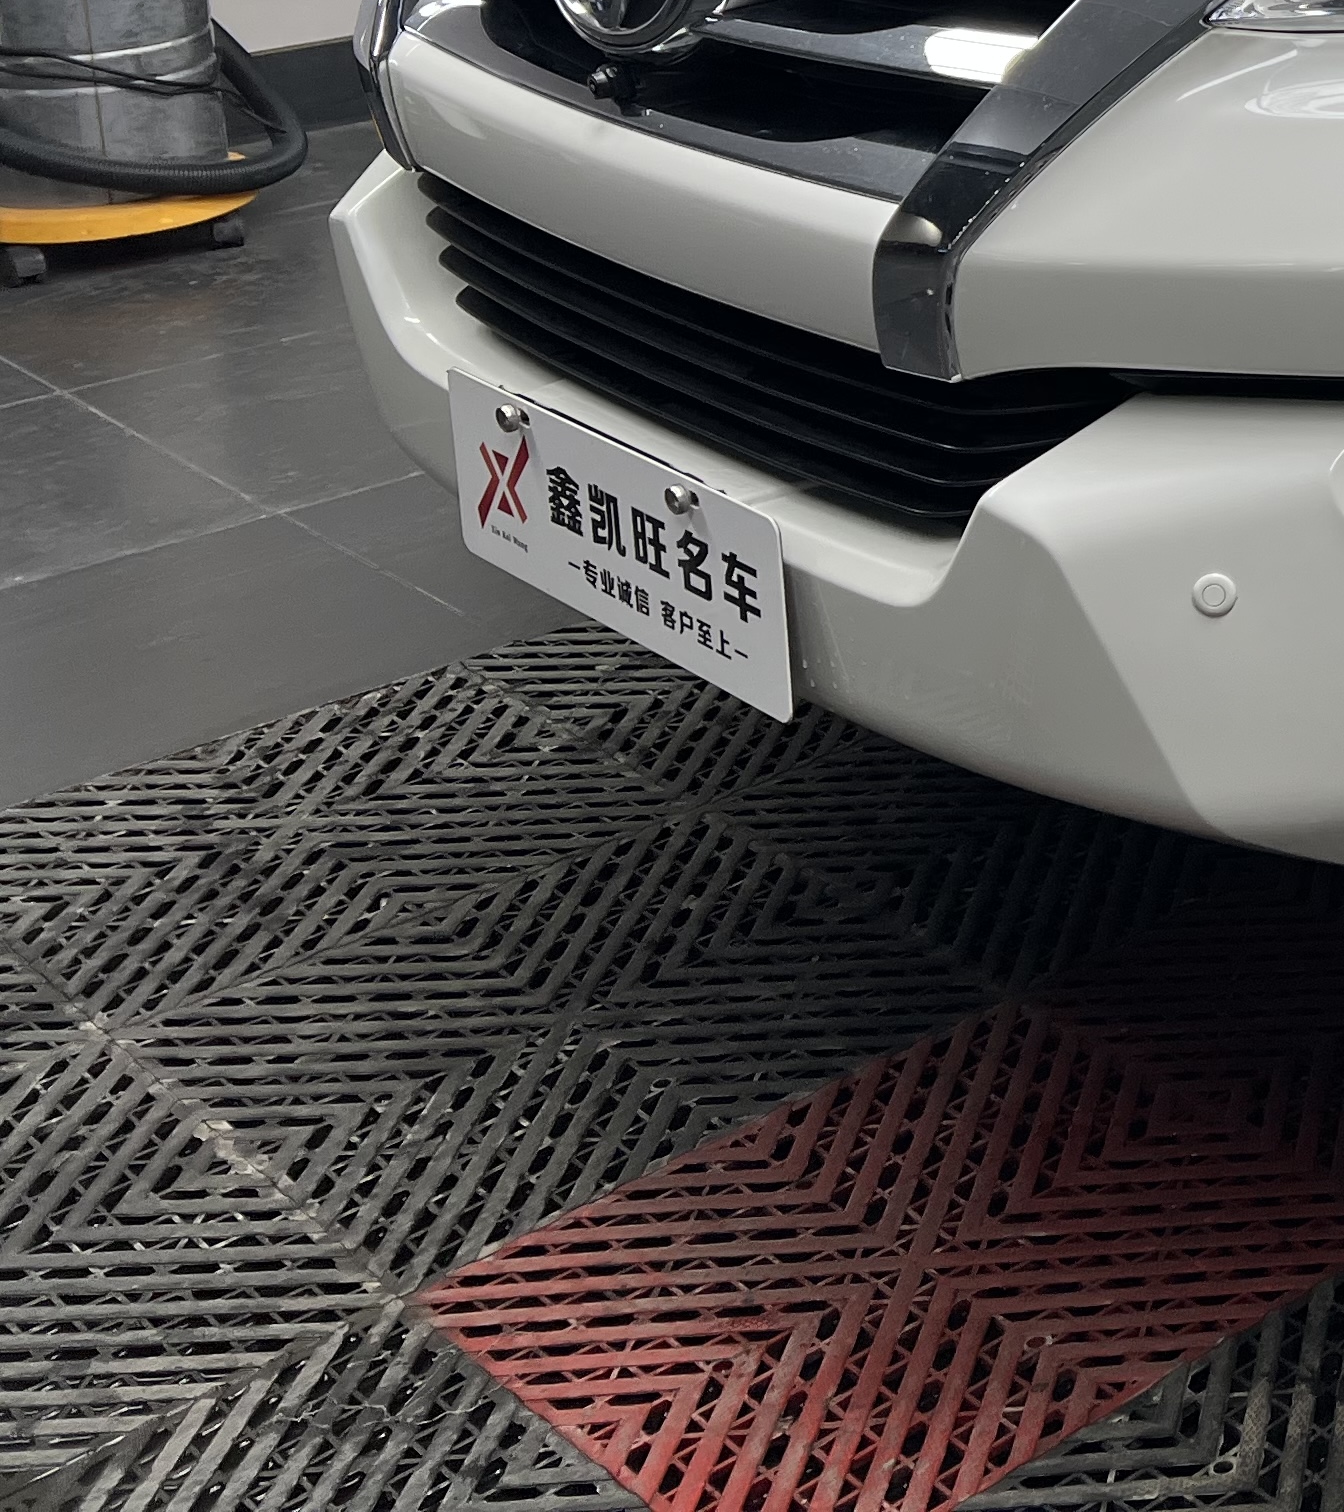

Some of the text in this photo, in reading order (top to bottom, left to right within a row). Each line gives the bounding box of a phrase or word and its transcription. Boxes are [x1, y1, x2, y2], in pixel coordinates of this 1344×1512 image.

[546, 465, 762, 623] 鑫凯旺名车
